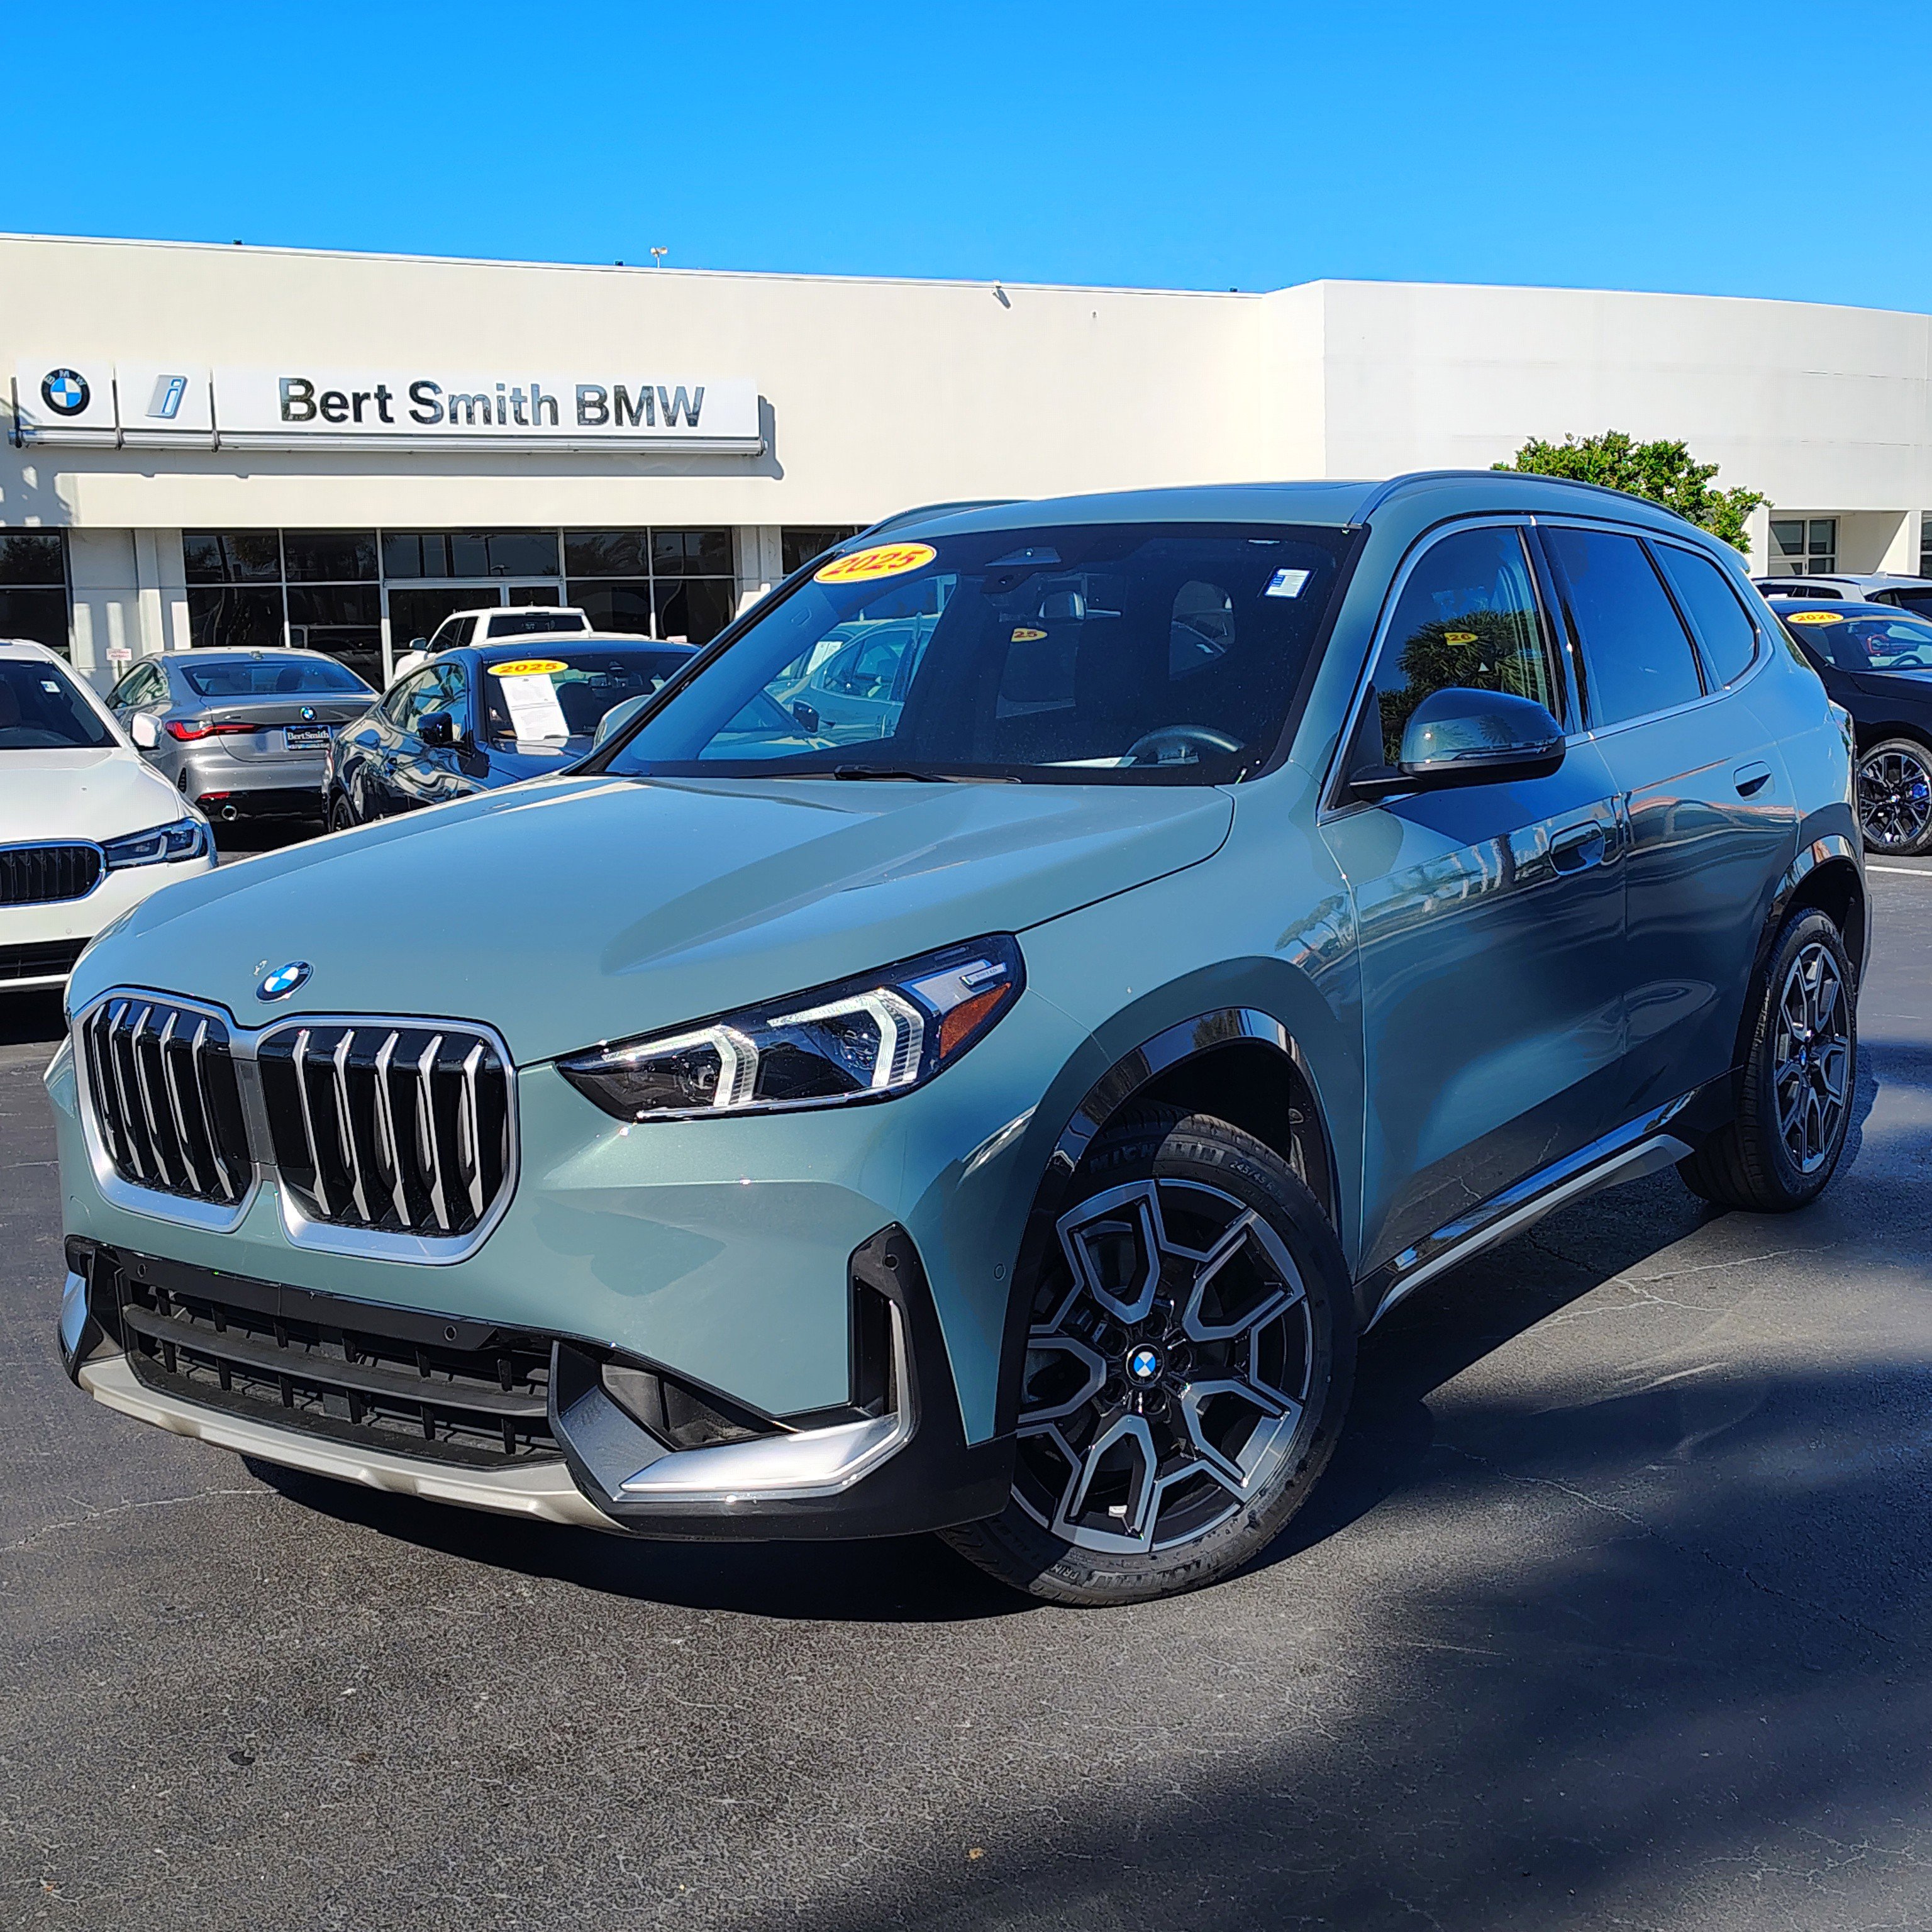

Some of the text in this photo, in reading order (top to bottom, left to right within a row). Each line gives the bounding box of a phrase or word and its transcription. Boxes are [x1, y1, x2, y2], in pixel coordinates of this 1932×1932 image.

[279, 377, 706, 427] Bert Smith BMW
[821, 549, 928, 577] 2025
[499, 663, 558, 674] 2025
